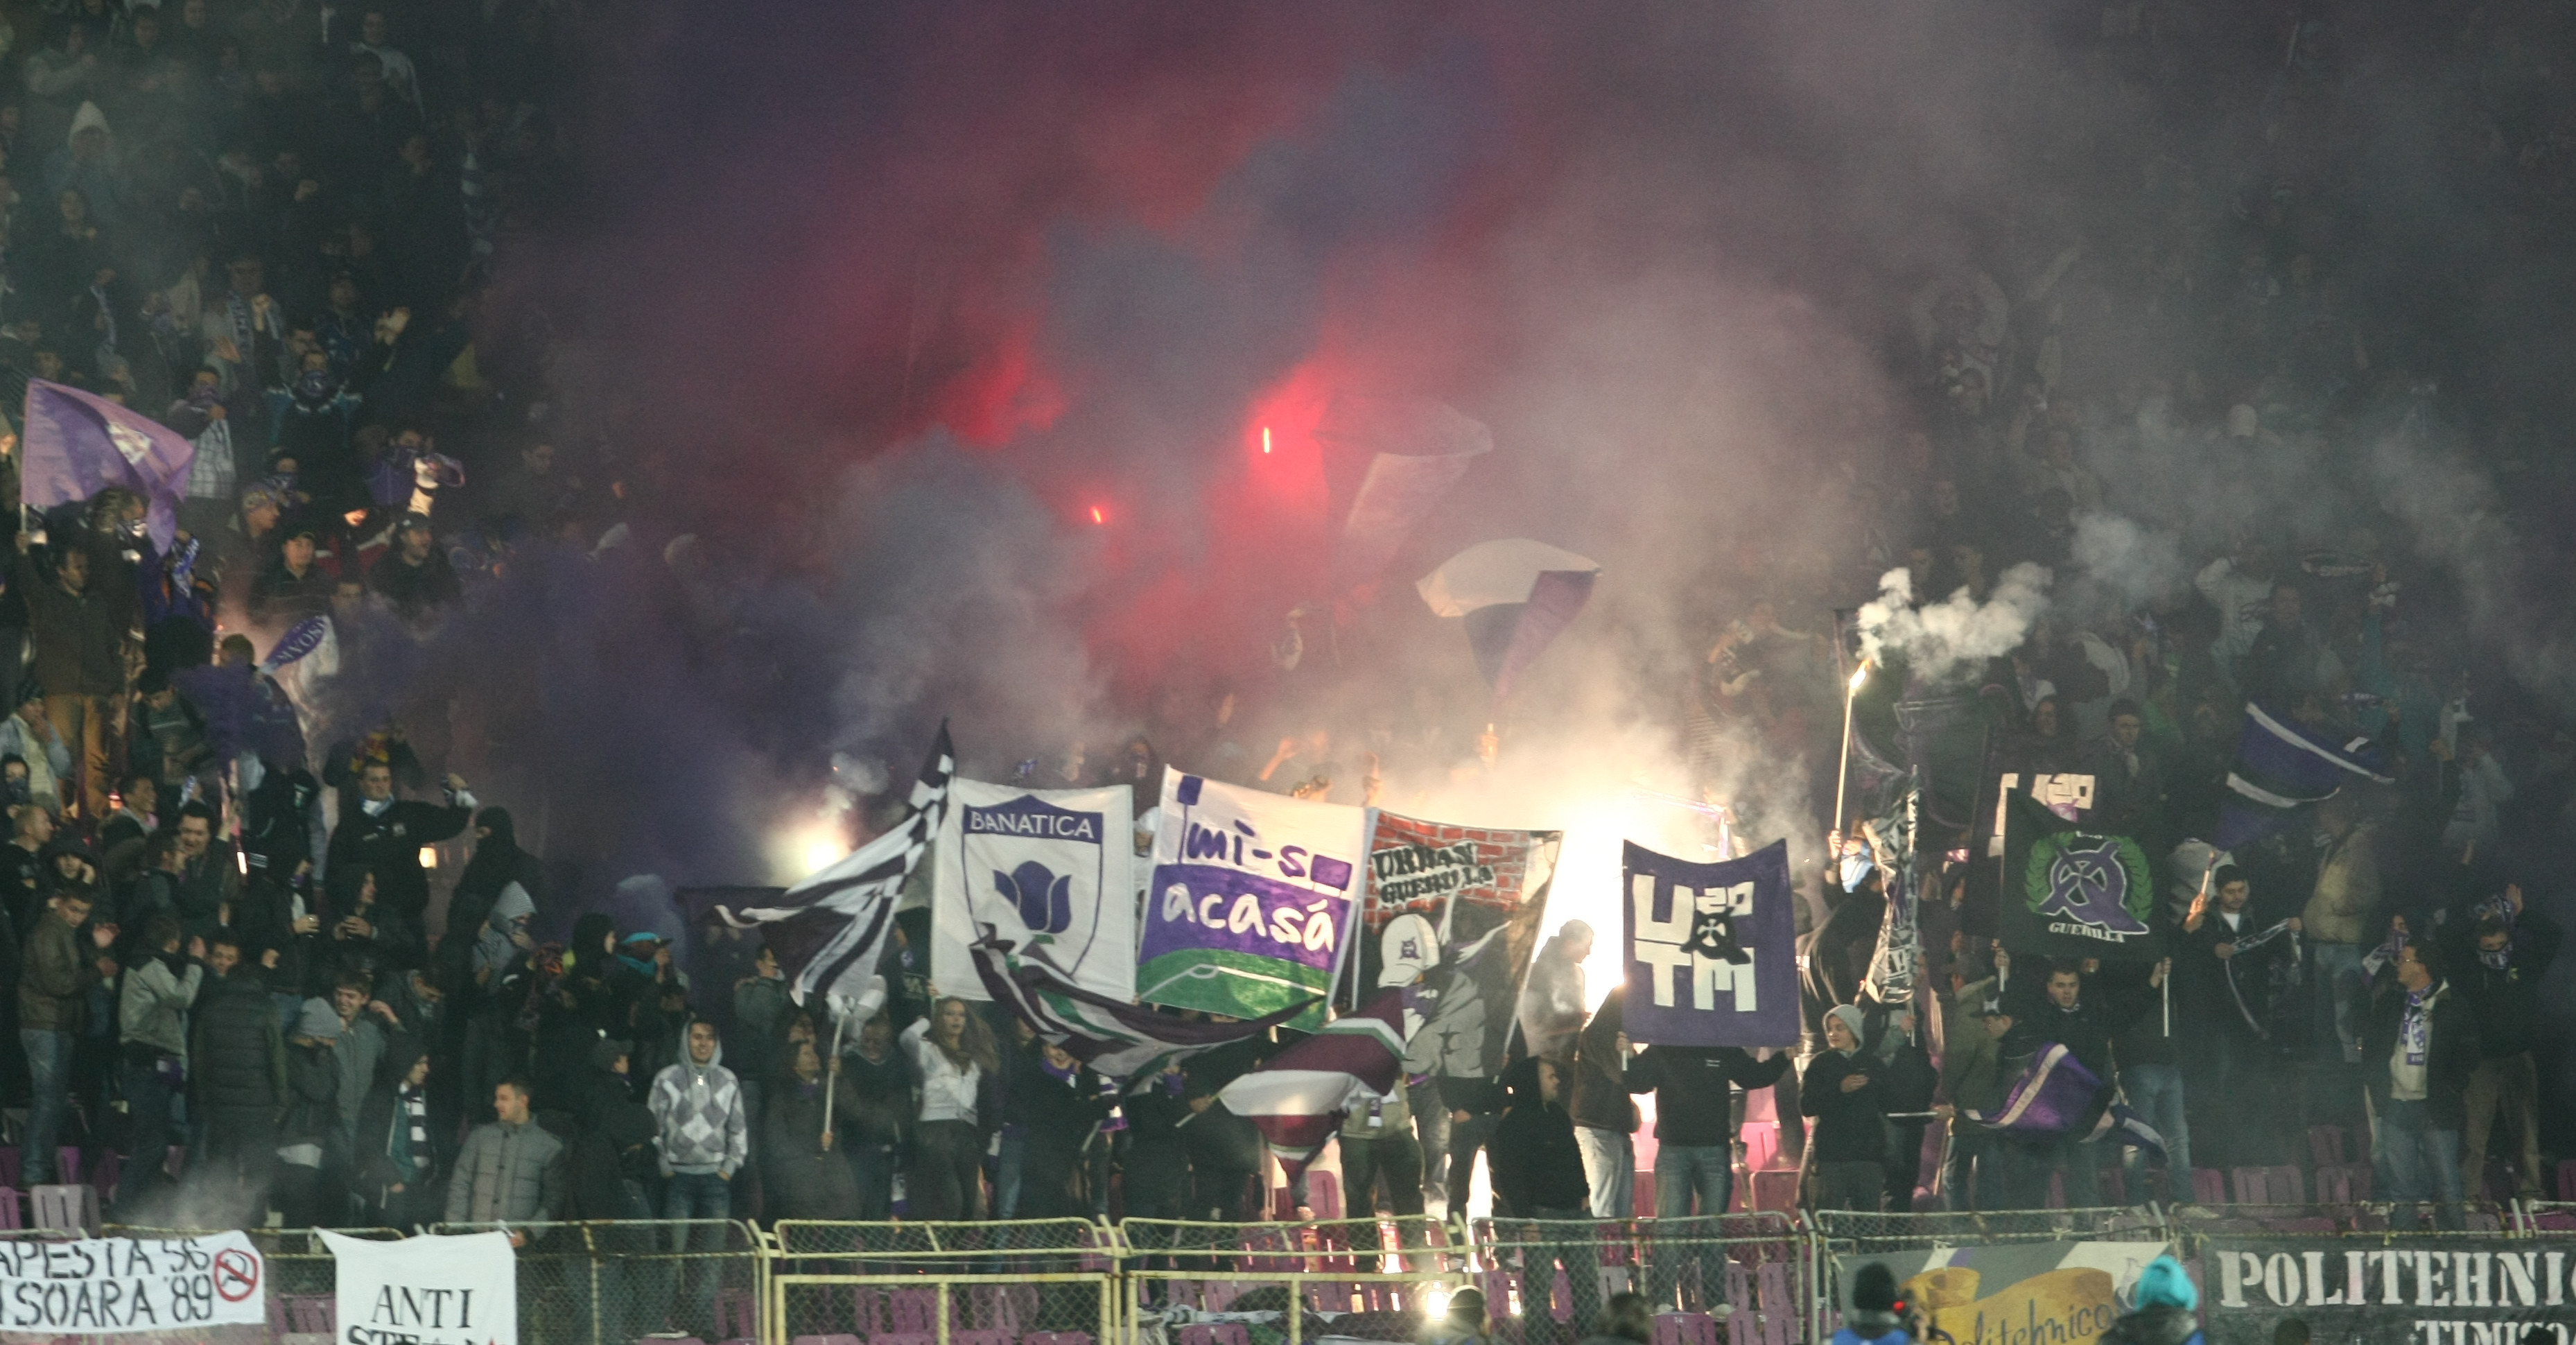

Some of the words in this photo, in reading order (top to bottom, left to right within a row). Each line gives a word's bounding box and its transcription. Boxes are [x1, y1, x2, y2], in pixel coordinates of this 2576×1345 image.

[970, 810, 1095, 839] BANATICA
[2218, 1250, 2576, 1308] POLITEHNI
[370, 1285, 475, 1328] ANTI
